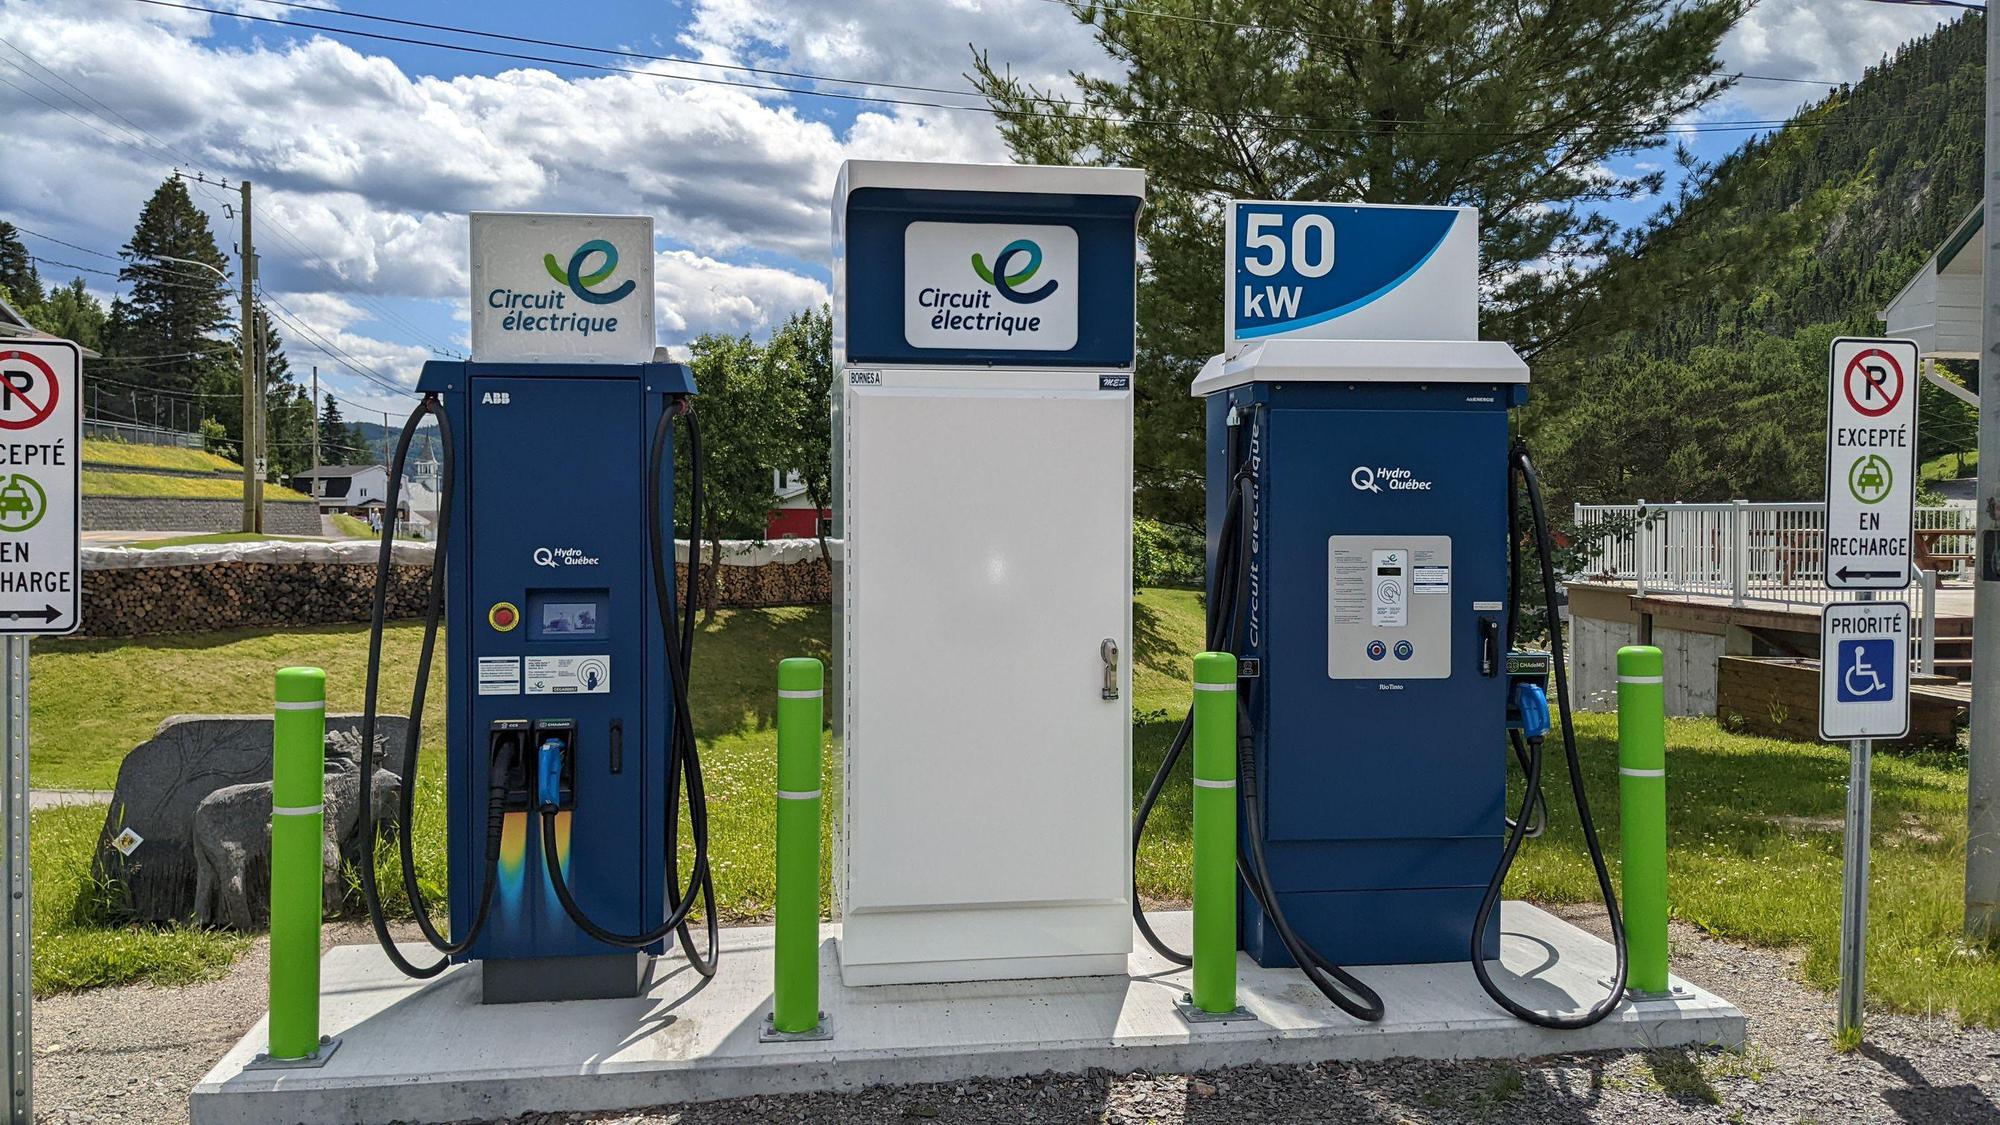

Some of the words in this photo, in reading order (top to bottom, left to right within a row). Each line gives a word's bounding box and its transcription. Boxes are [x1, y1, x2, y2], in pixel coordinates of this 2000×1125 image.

[1244, 213, 1335, 278] 50
[489, 288, 566, 310] Circuit
[918, 288, 991, 308] Circuit
[1243, 285, 1303, 318] kW
[502, 310, 618, 336] électrique
[931, 309, 1041, 336] électrique
[850, 372, 875, 384] BORNES
[875, 372, 881, 384] A
[481, 392, 511, 404] ABB
[1837, 424, 1907, 447] EXCEPTÉ
[1376, 467, 1412, 480] Hydro
[1389, 479, 1432, 490] Québec
[1859, 512, 1880, 531] EN
[0, 542, 29, 562] EN
[554, 547, 582, 558] Hydro
[1830, 537, 1907, 556] RECHARGE
[564, 555, 600, 565] Québec
[1249, 561, 1259, 648] Circuit
[1831, 613, 1902, 634] PRIORITÉ
